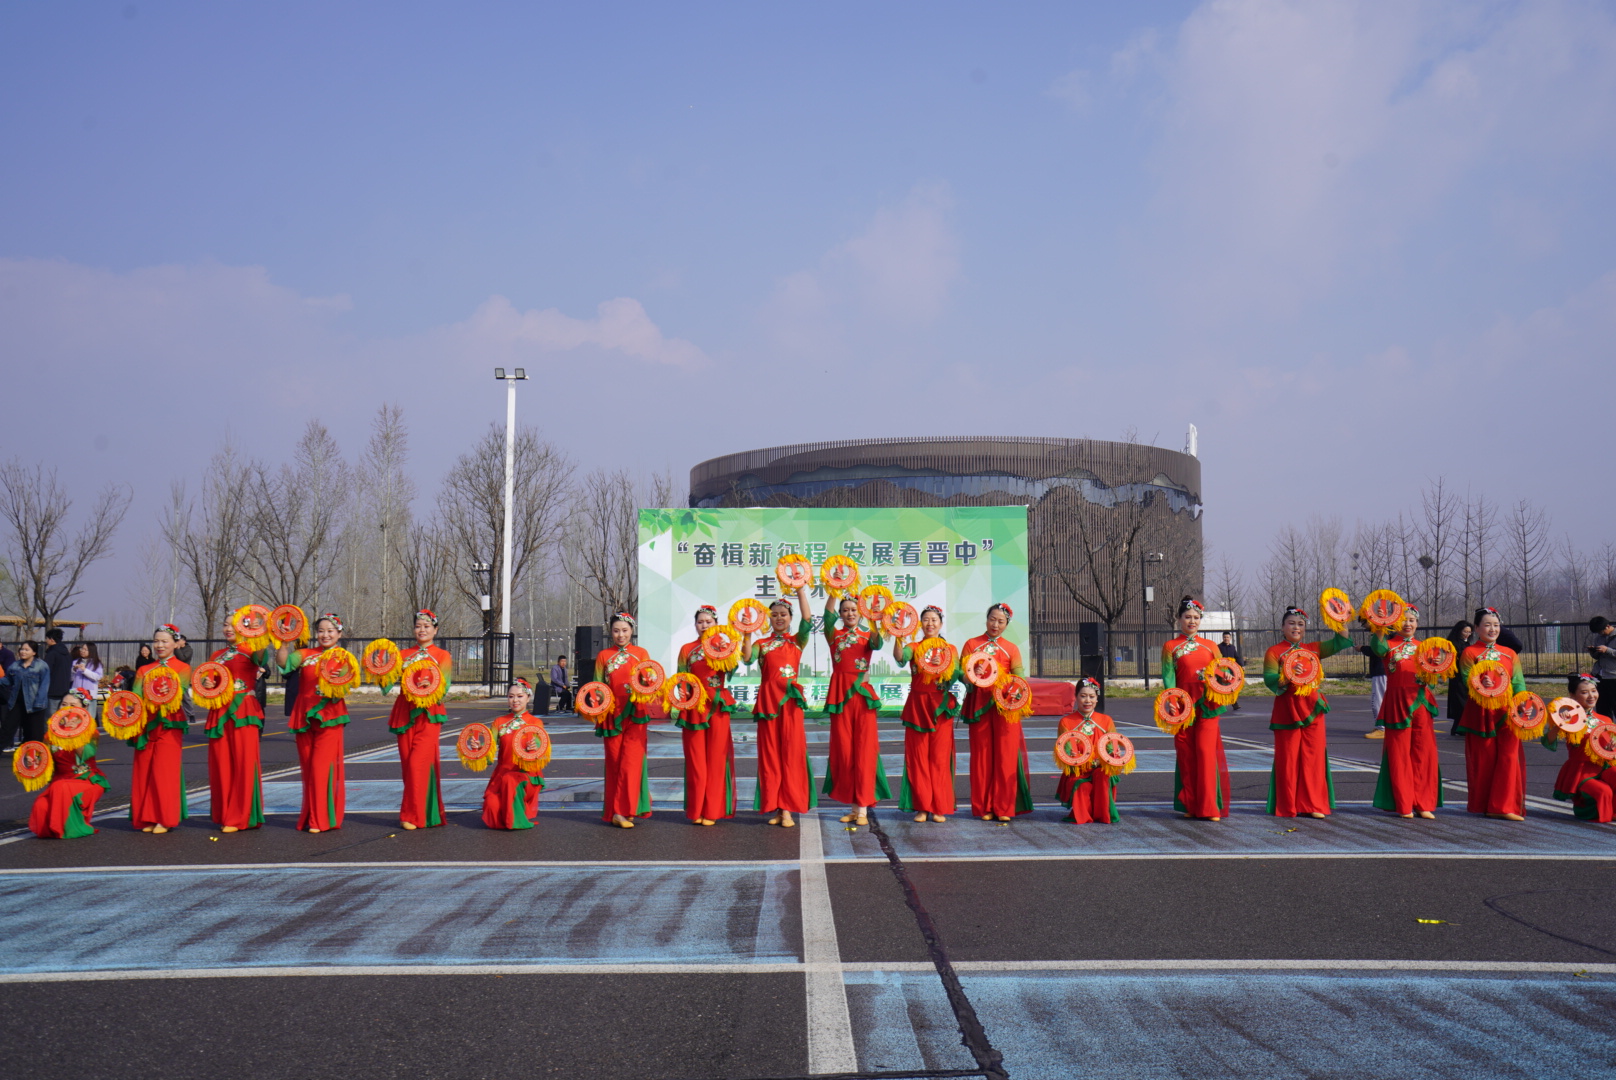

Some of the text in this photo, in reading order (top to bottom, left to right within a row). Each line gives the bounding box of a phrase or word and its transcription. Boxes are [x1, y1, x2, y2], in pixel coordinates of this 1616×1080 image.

[843, 539, 993, 566] 发展看晋中”
[754, 574, 917, 598] 主活动
